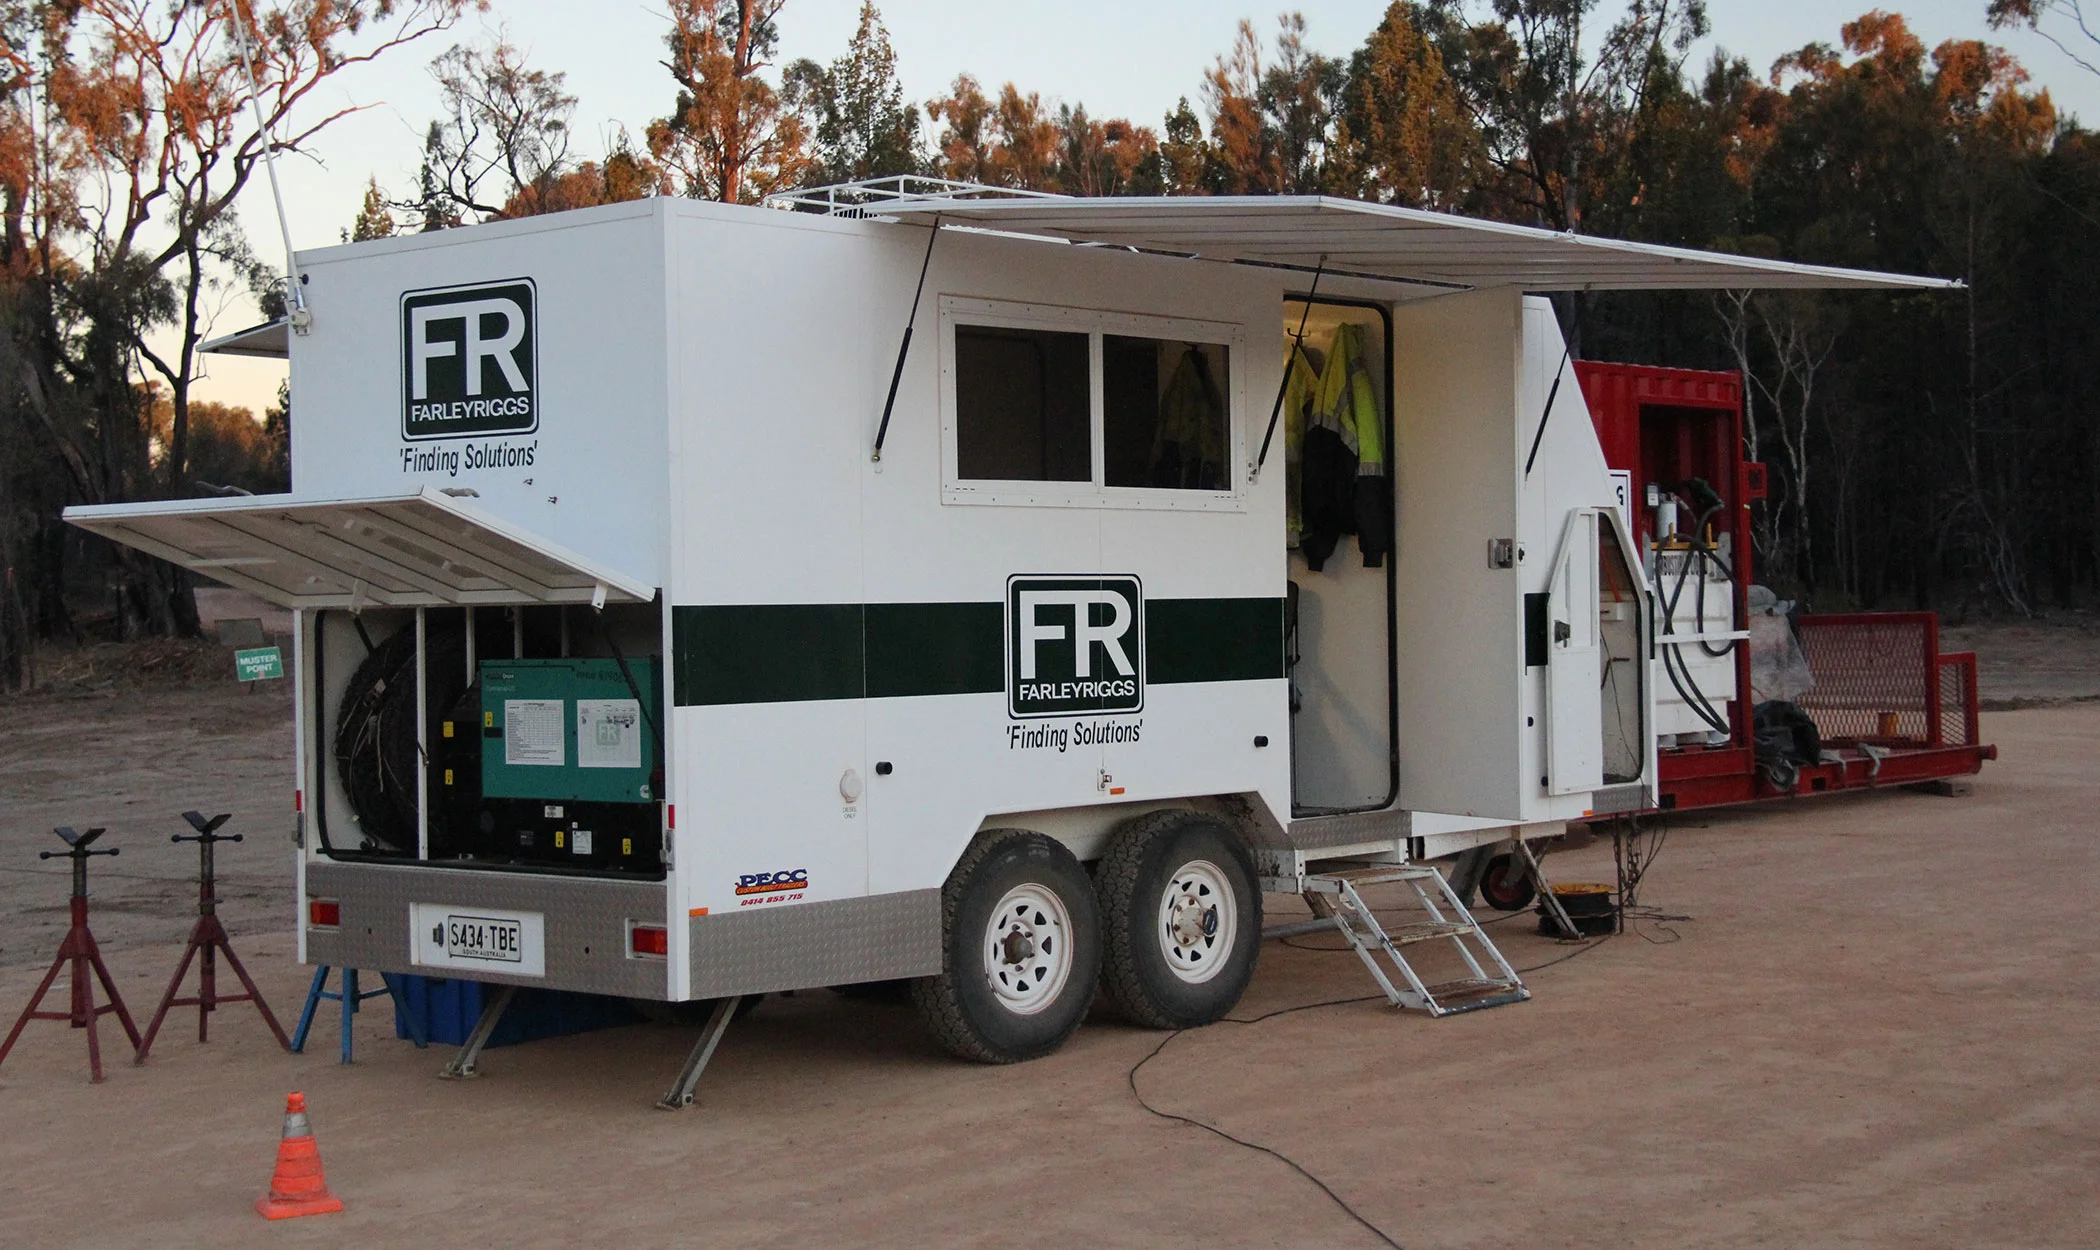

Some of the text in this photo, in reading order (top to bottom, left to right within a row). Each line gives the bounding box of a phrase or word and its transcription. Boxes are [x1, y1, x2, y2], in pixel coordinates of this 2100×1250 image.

[411, 297, 530, 400] FR
[411, 396, 530, 422] FARLEYRIGGS
[400, 440, 538, 477] 'Finding Solutions'
[1019, 590, 1136, 679] FR
[240, 654, 277, 665] MUSTER
[246, 663, 273, 673] POINT
[1019, 679, 1136, 701] FARLEYRIGGS
[1006, 718, 1143, 753] 'Finding Solutions'
[739, 868, 808, 888] PECC
[741, 897, 764, 906] 0414
[787, 892, 804, 901] 715
[480, 950, 507, 958] AUSTRALIA
